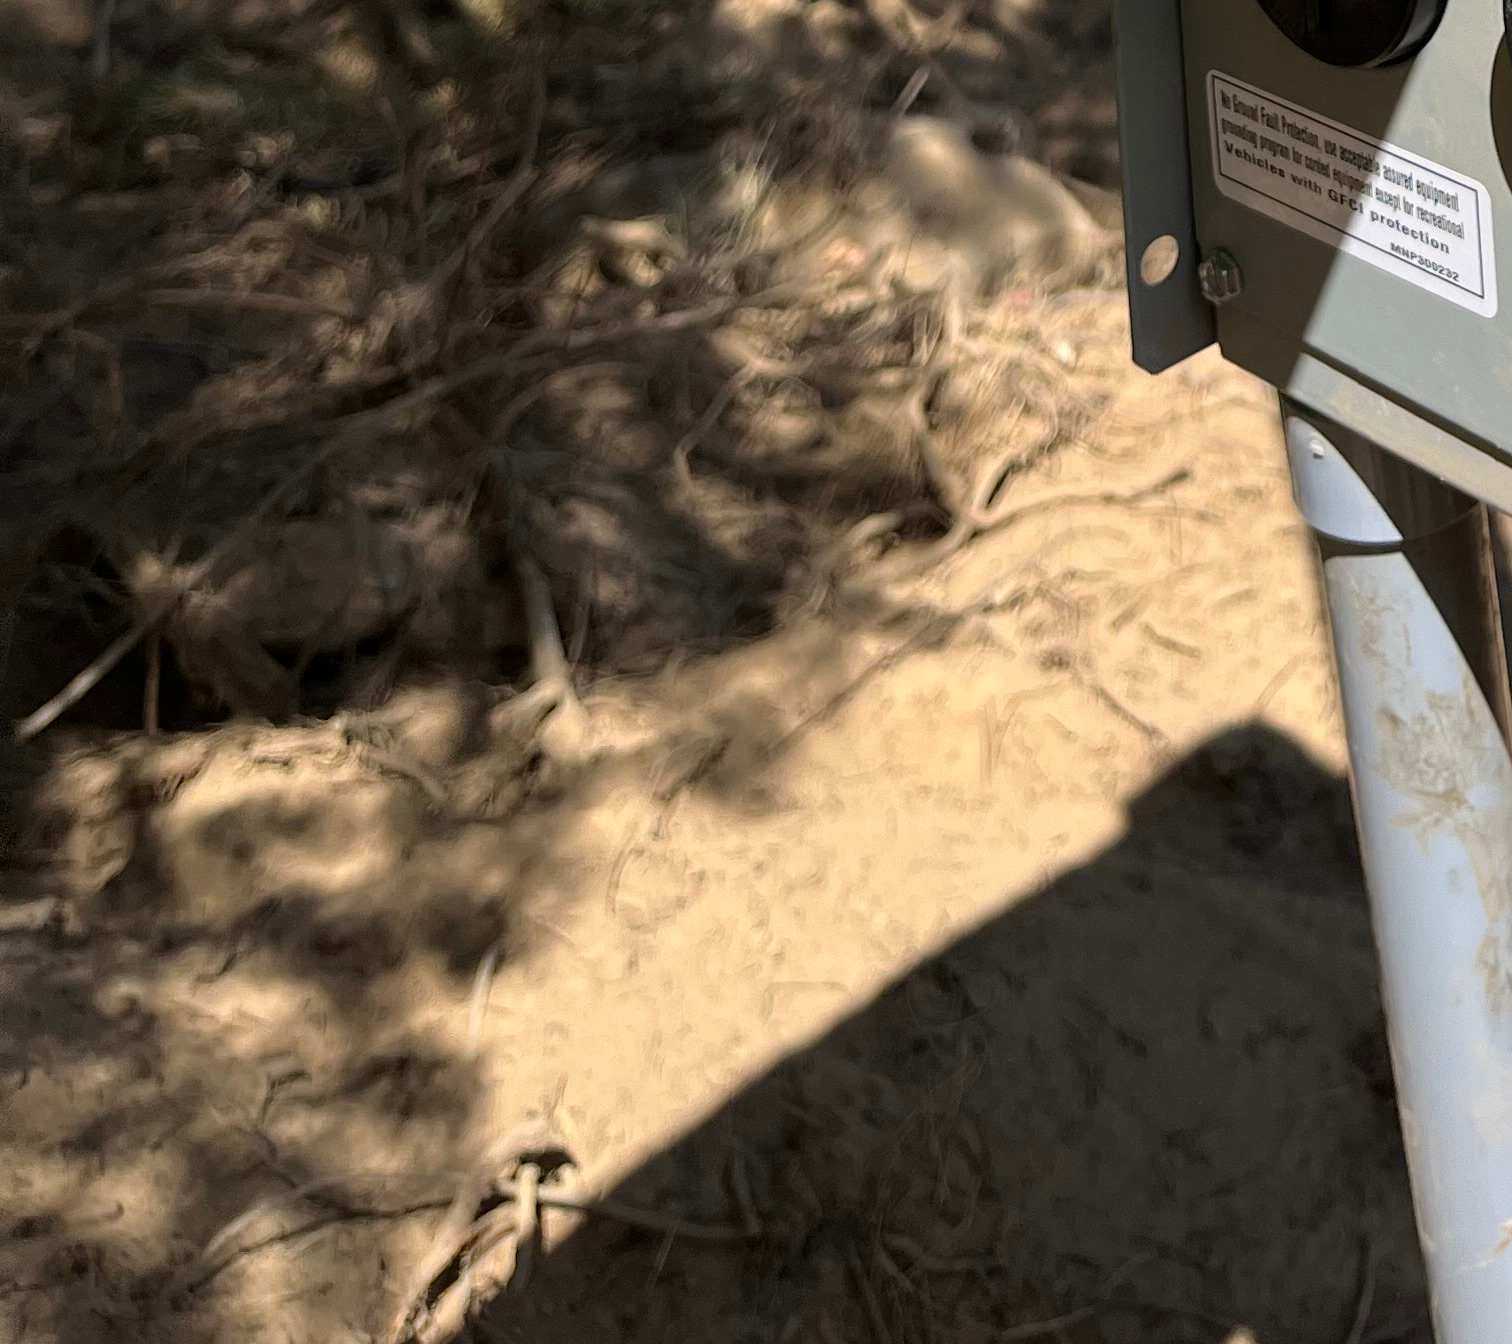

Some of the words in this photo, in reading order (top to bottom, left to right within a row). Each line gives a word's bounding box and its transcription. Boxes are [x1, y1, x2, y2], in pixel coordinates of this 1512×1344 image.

[1224, 139, 1285, 178] Vehicles
[1290, 170, 1322, 195] with
[1327, 187, 1363, 214] GFCI
[1369, 207, 1449, 255] protection
[1375, 184, 1401, 214] except
[1402, 195, 1414, 217] for
[1415, 202, 1464, 240] recreational
[1382, 160, 1413, 192] assured
[1415, 175, 1459, 215] equipment
[1390, 241, 1459, 282] MNP300232
